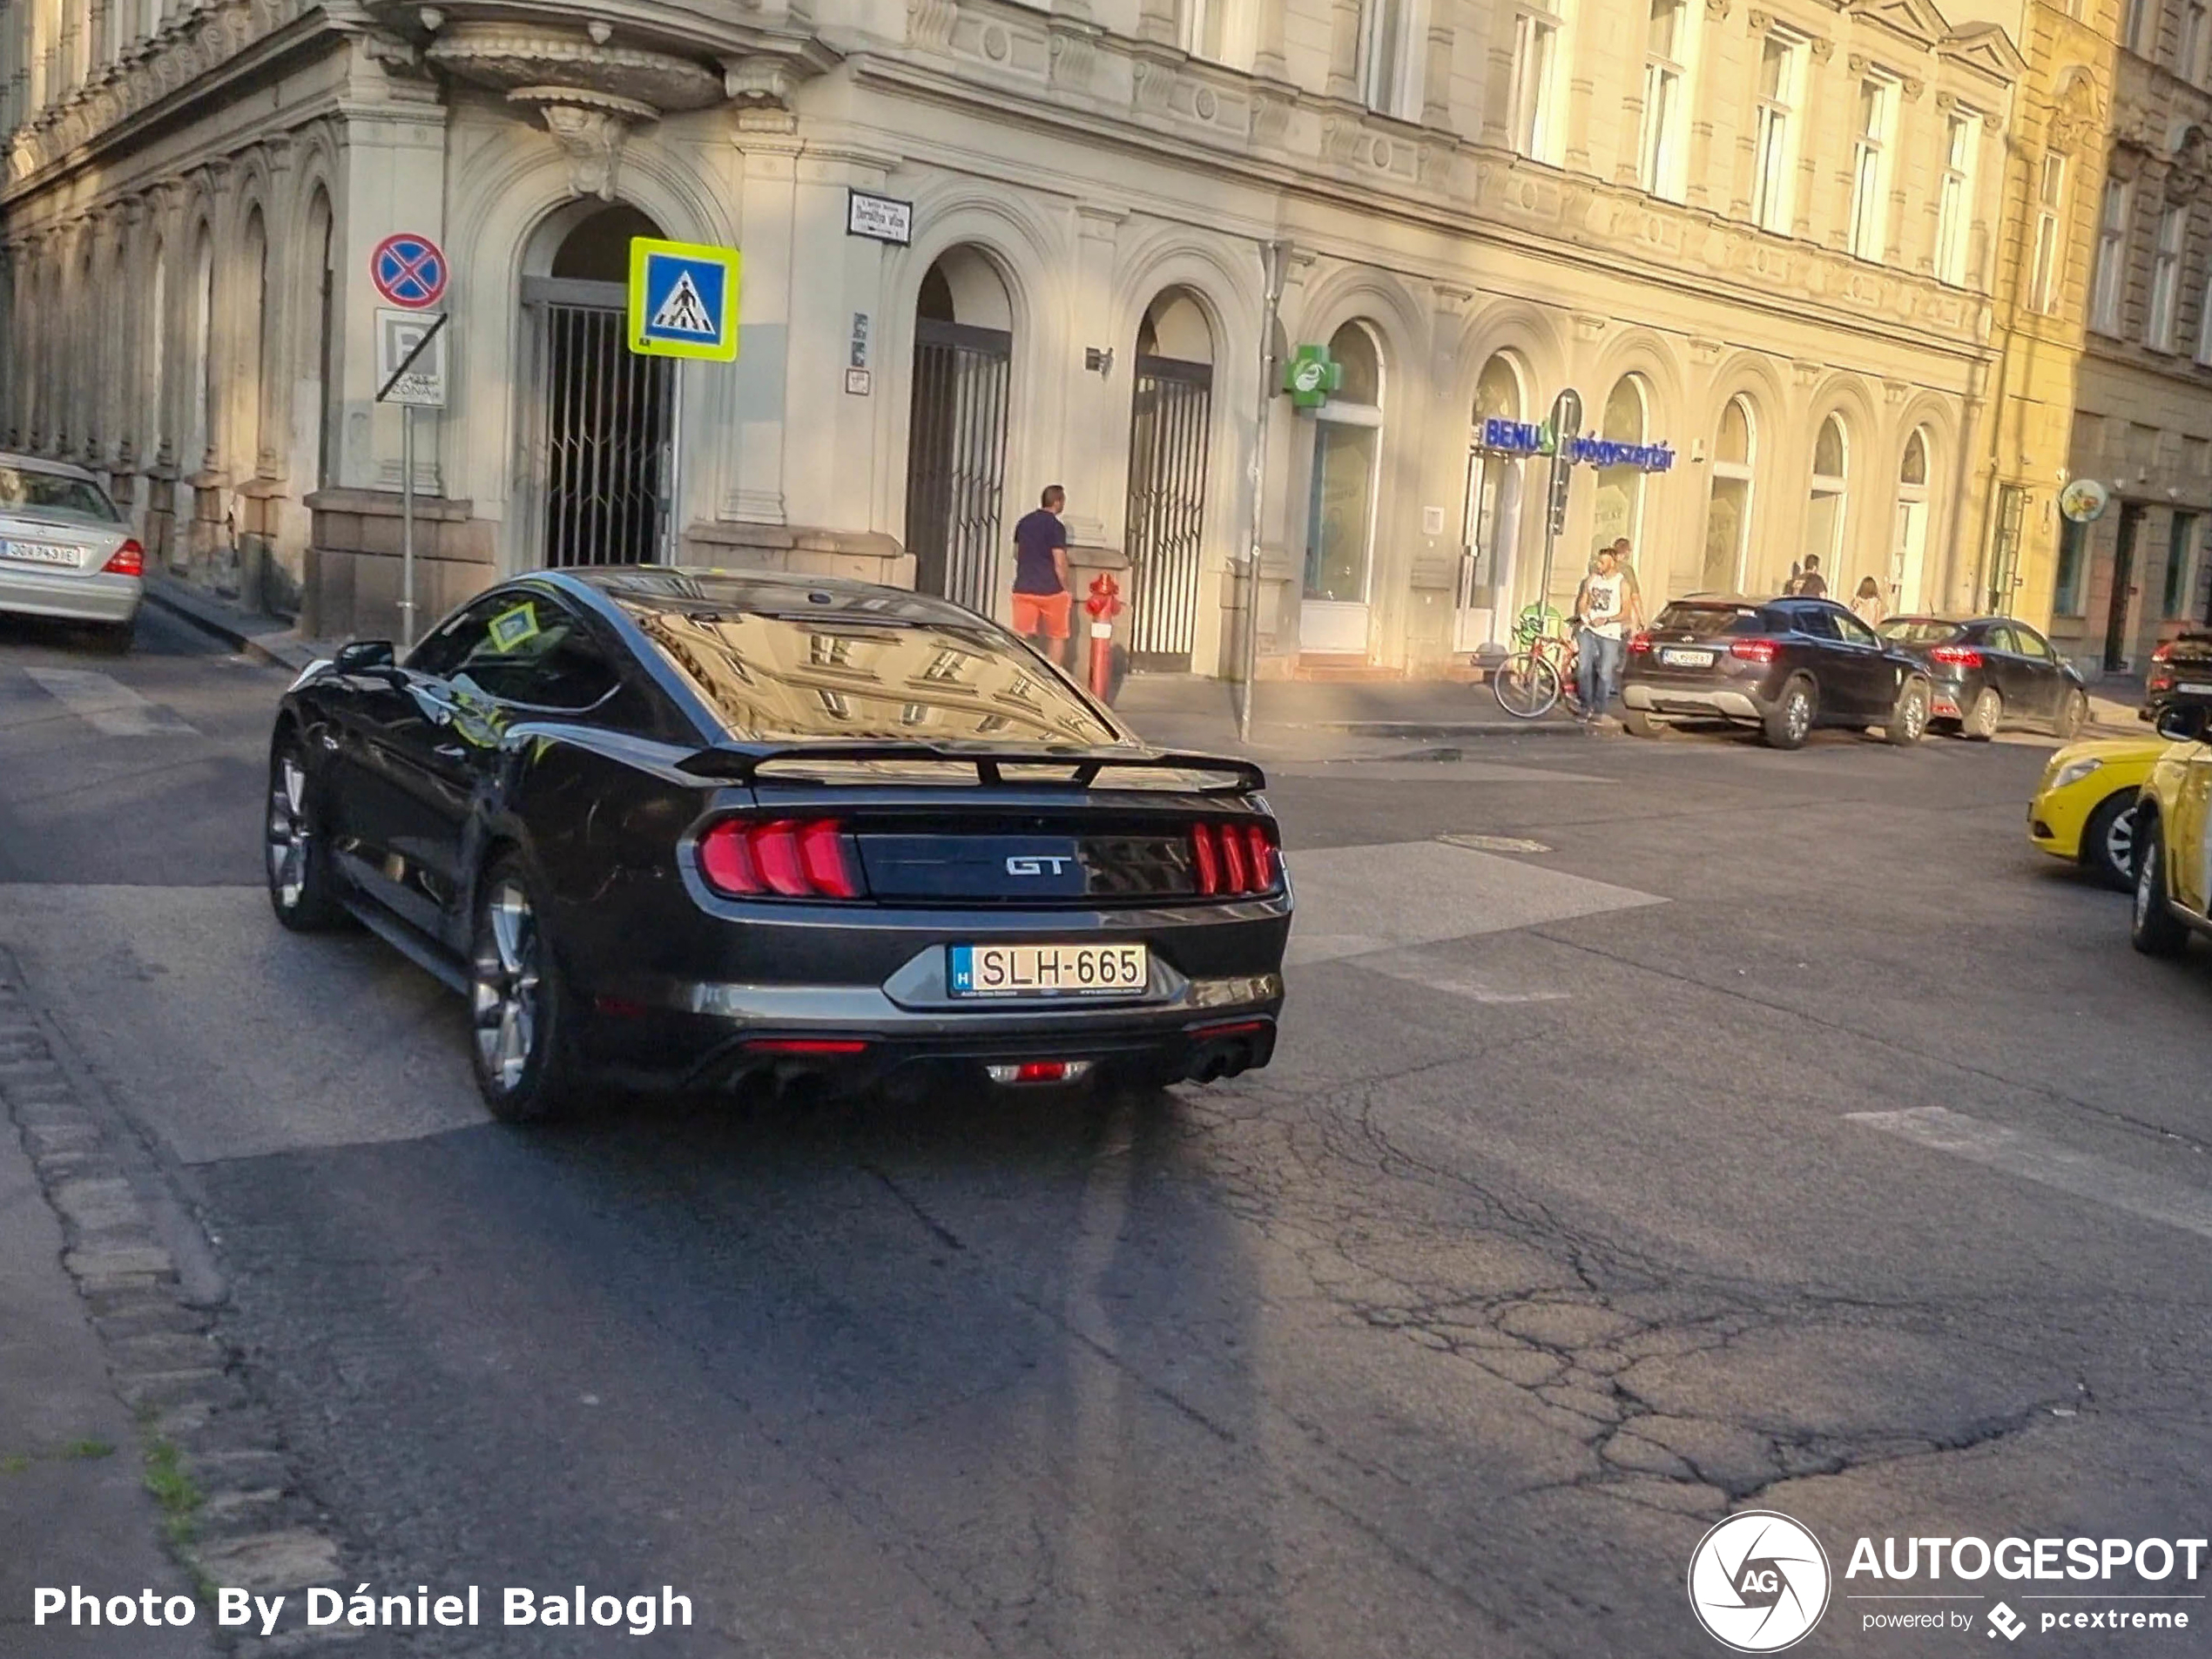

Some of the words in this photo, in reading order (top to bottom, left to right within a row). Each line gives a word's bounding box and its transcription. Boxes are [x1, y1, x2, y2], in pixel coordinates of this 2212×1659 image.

[1486, 418, 1541, 451] BENU
[1007, 856, 1071, 875] GT
[958, 973, 968, 985] H
[982, 950, 1138, 985] SLH-665
